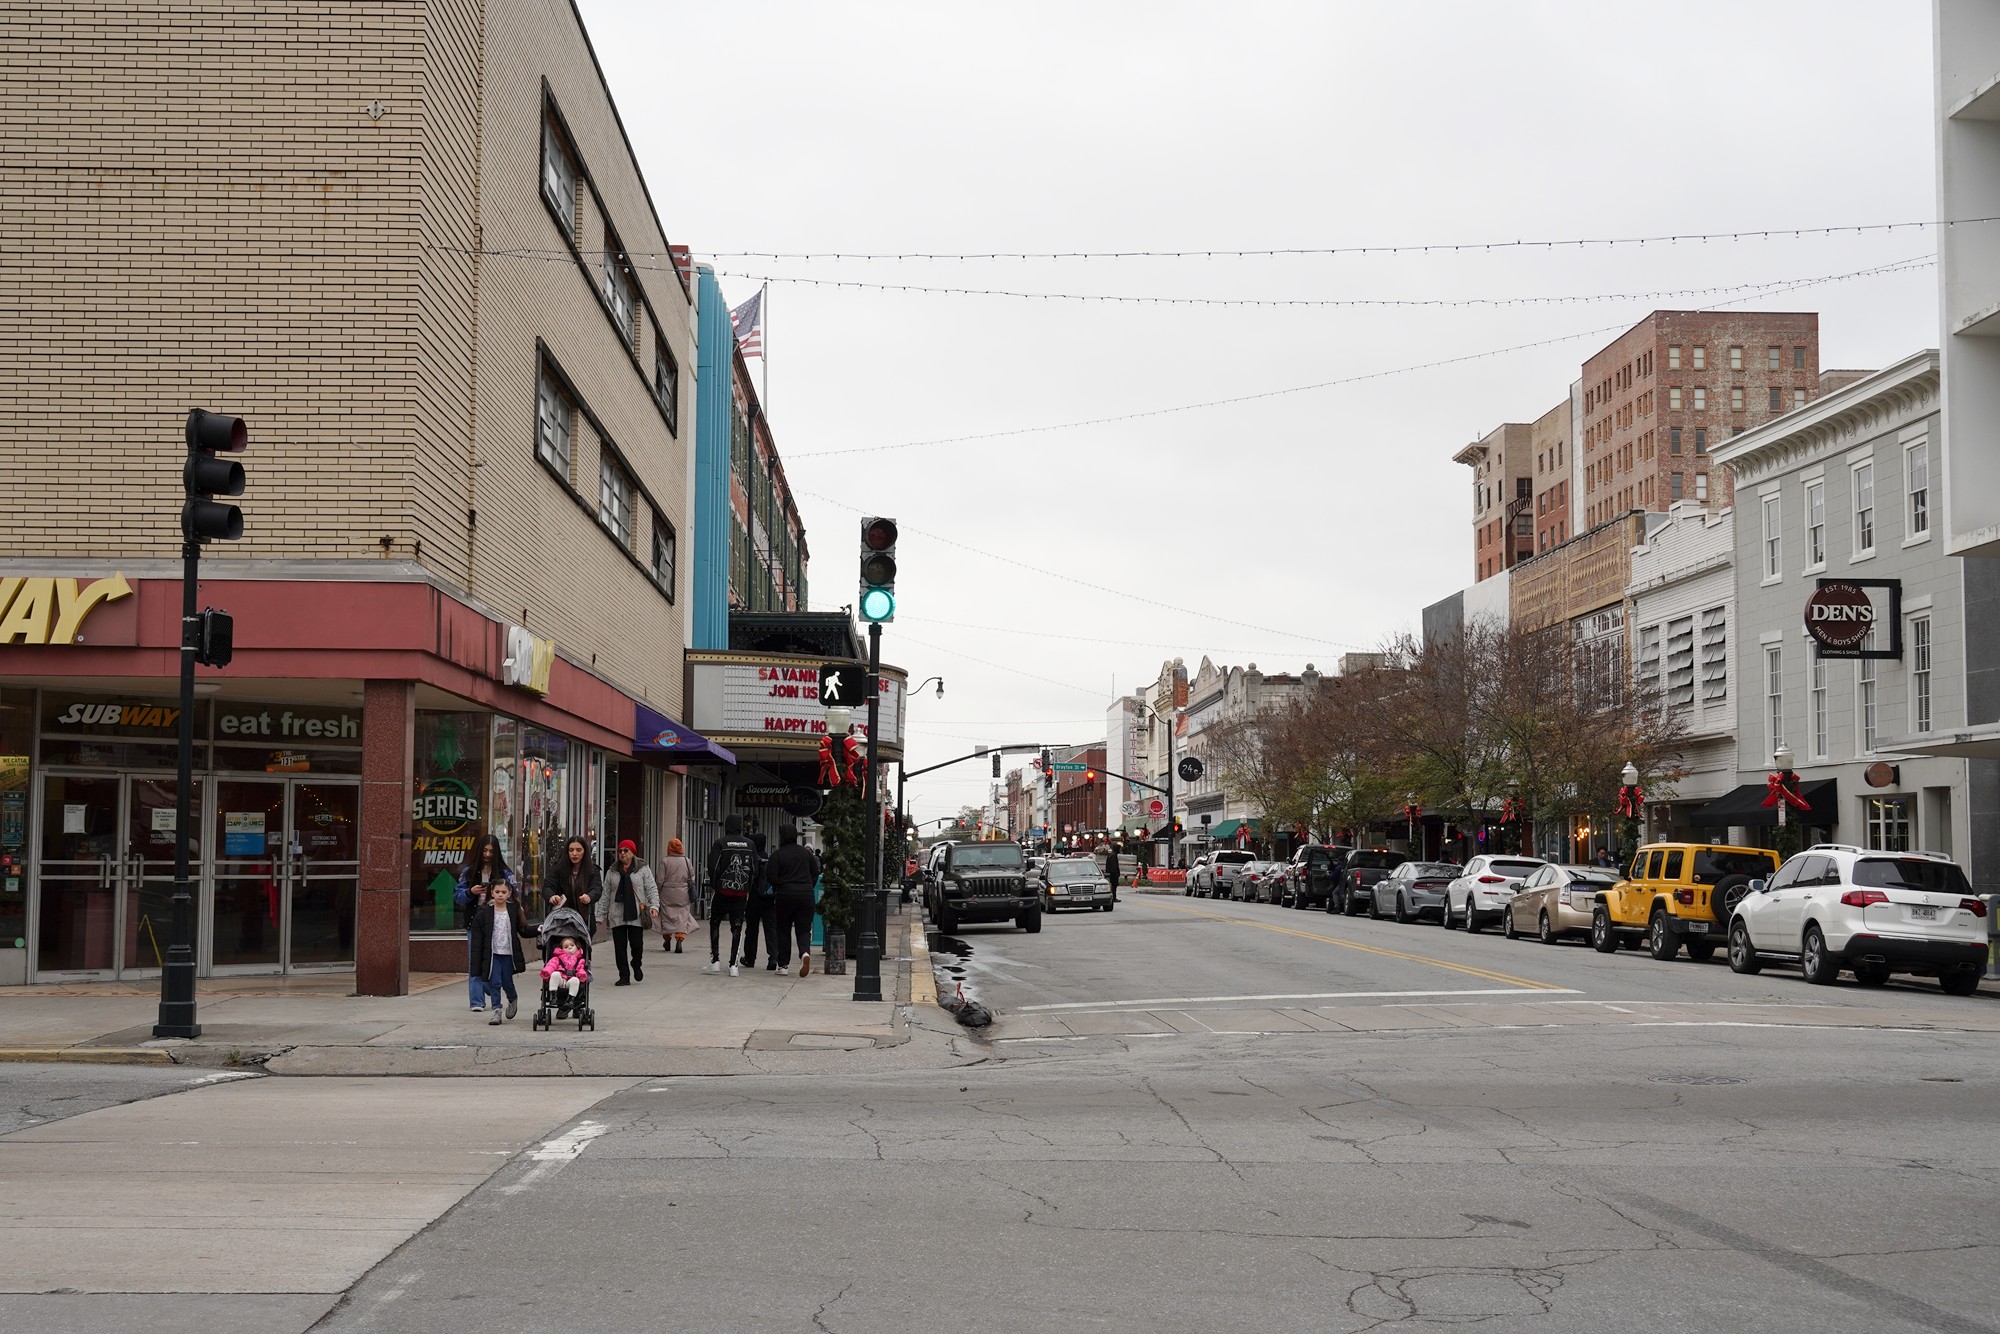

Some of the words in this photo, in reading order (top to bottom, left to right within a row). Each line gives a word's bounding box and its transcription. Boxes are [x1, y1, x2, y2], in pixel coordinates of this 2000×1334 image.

[1824, 584, 1840, 594] EST.
[1841, 584, 1857, 594] 1985
[1811, 604, 1872, 621] DEN'S
[1814, 625, 1828, 640] MEN
[1832, 638, 1852, 646] BOYS
[1851, 625, 1867, 643] SHOP
[758, 667, 818, 682] SAVANN
[768, 684, 799, 699] JOIN
[58, 703, 181, 727] SUBWAY
[220, 711, 271, 735] eat
[280, 711, 358, 738] fresh
[764, 717, 808, 732] HAPPY
[746, 784, 792, 795] Savannah
[412, 795, 478, 821] SERIES
[413, 836, 476, 850] ALL-NEW
[423, 850, 465, 865] MENU
